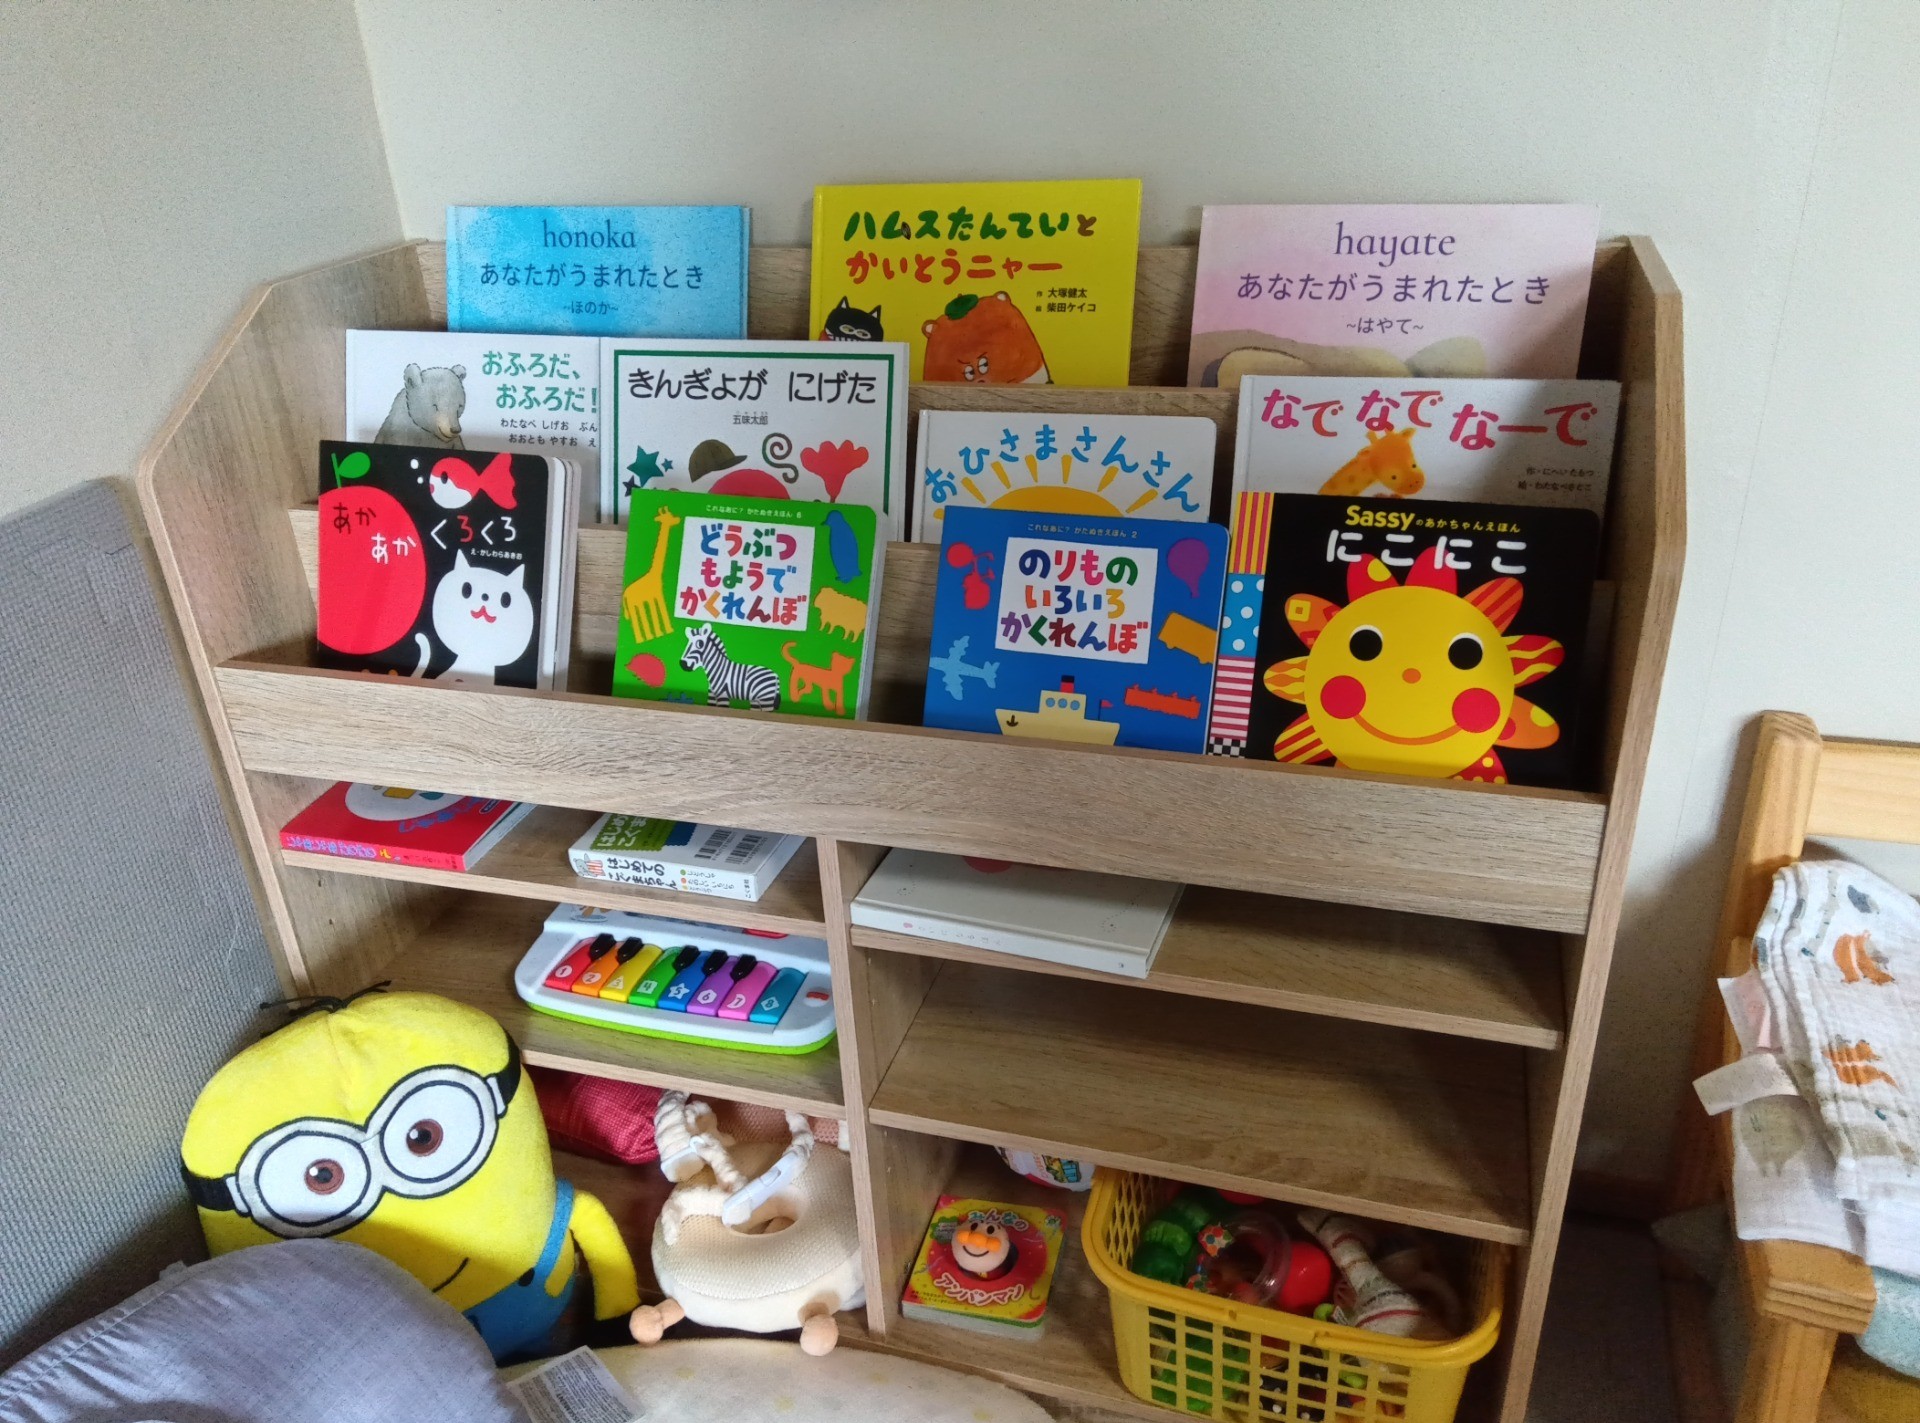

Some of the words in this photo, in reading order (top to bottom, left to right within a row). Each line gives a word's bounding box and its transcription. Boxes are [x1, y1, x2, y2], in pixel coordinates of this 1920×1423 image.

[543, 218, 637, 249] honoka
[843, 206, 1097, 241] ハムスたんていと
[1333, 221, 1457, 267] hayate
[480, 262, 704, 290] あなたがうまれたとき
[845, 248, 1063, 285] かいとうニャー
[1237, 272, 1551, 305] あなたがうまれたとき
[628, 367, 768, 401] きんぎょが
[788, 369, 877, 404] にげた
[500, 417, 537, 429] わたなべ
[542, 420, 569, 431] しげお
[578, 421, 598, 432] ぶん
[508, 432, 545, 445] おおとも
[549, 436, 578, 447] やすお
[925, 424, 1200, 513] おひさまさんさん
[333, 502, 377, 534] あか
[430, 515, 517, 550] くろくろ
[371, 532, 417, 565] あか
[700, 522, 797, 560] どうぶつ
[1326, 529, 1527, 575] にこにこ
[700, 557, 797, 593] もようで
[1018, 548, 1139, 587] のりもの
[680, 586, 807, 626] かくれんぼ
[1025, 584, 1125, 619] いろいろ
[1000, 611, 1149, 654] かくれんぼ
[606, 857, 666, 877] はじめての
[608, 872, 678, 890] こぐまちゃん
[585, 974, 596, 982] 2
[642, 982, 652, 991] 4
[673, 986, 683, 995] 5
[701, 993, 711, 1001] 6
[734, 997, 743, 1006] 7
[765, 999, 774, 1008] 8
